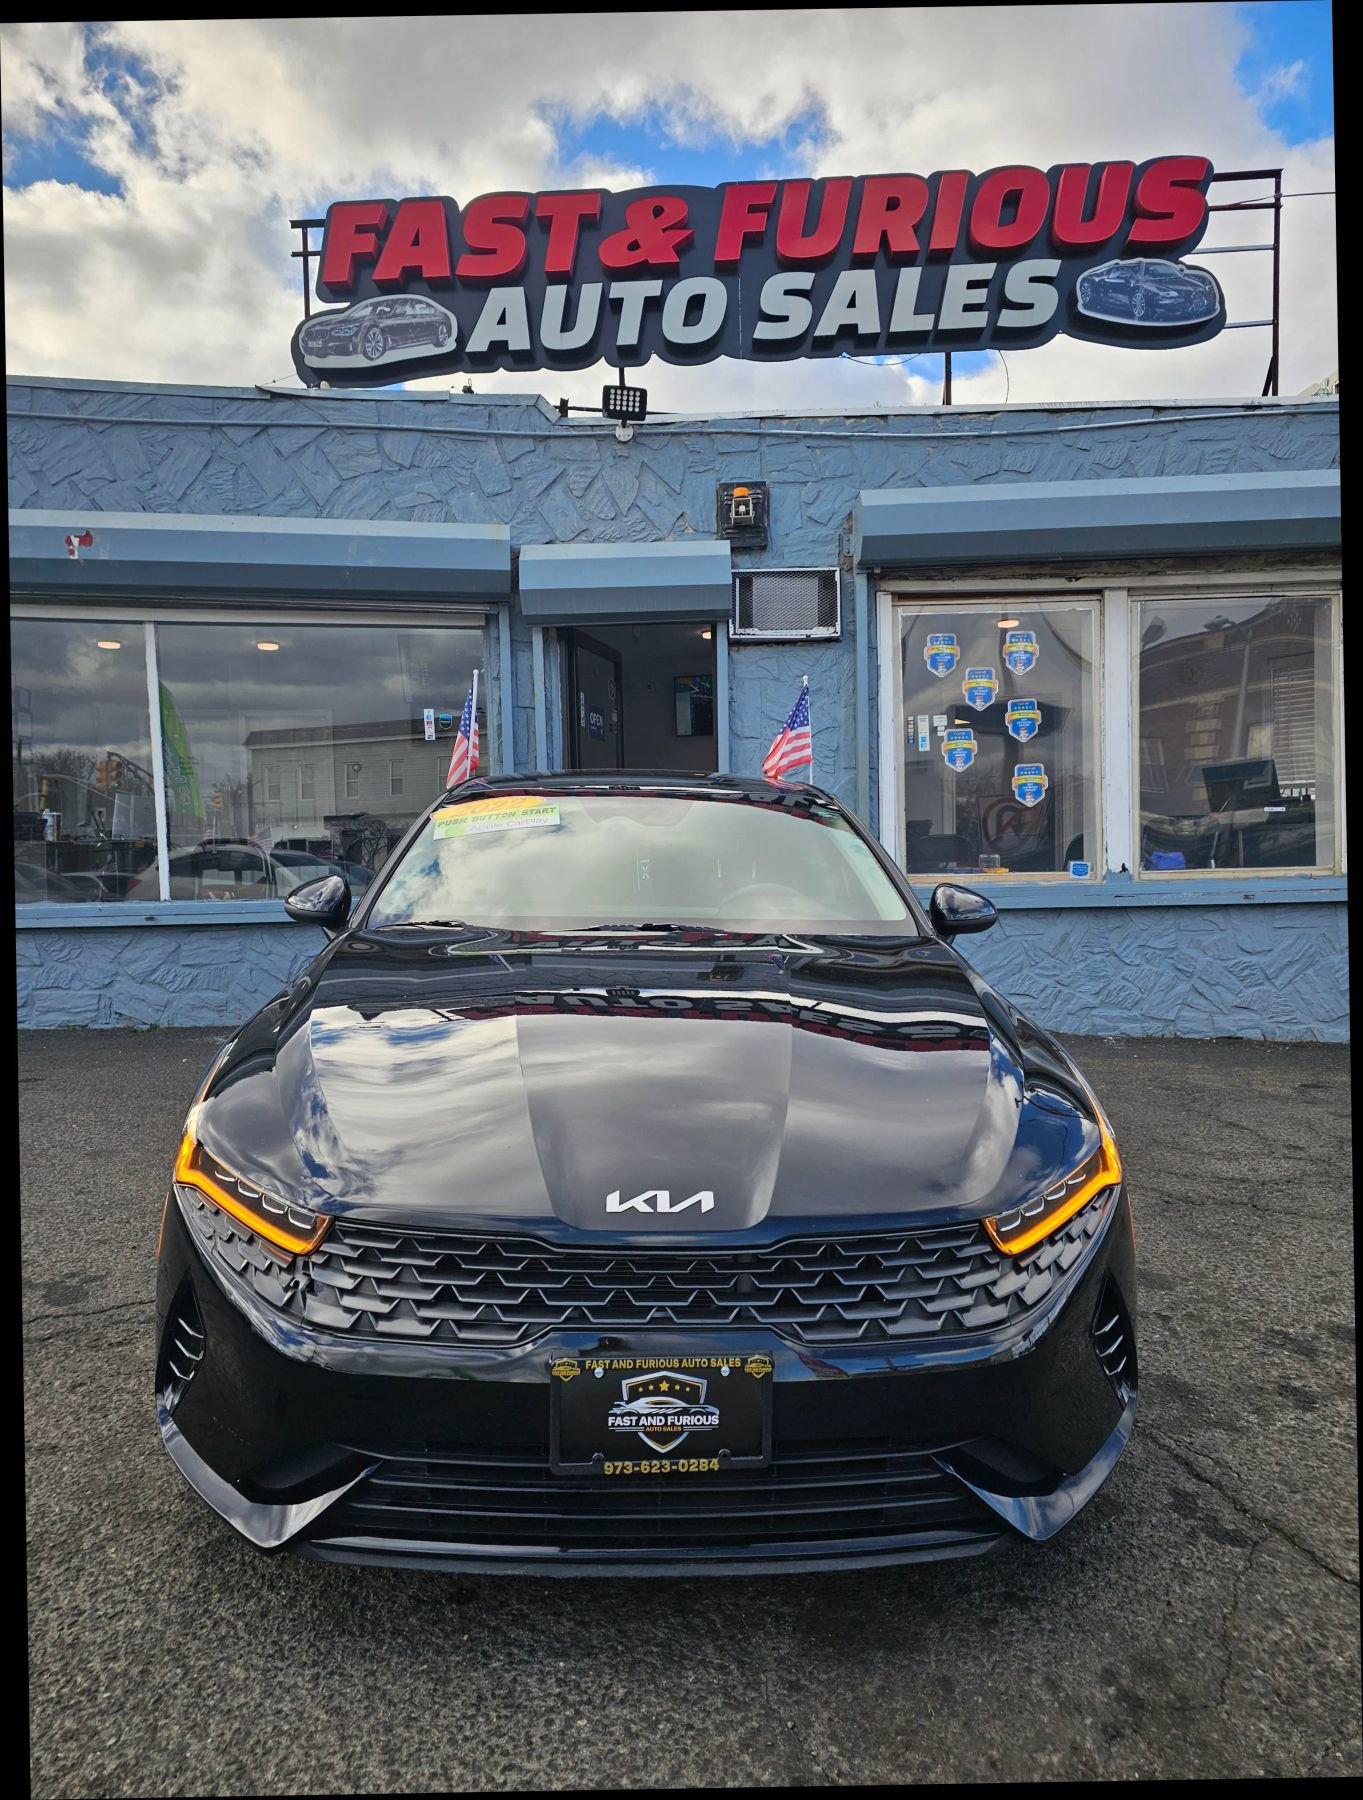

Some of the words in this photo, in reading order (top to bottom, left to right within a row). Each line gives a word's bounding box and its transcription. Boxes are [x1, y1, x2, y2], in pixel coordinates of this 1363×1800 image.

[323, 192, 601, 287] FAST
[599, 196, 695, 271] &
[714, 156, 1212, 264] FURIOUS
[465, 276, 728, 353] AUTO
[753, 259, 1061, 340] SALES
[590, 711, 604, 727] OPEN
[438, 817, 468, 828] PUSH
[471, 811, 517, 823] BUTTON
[521, 806, 557, 816] START
[470, 822, 504, 833] Apple
[506, 816, 550, 827] CarPlay
[606, 1190, 715, 1214] KIA
[585, 1359, 610, 1369] FAST
[612, 1359, 634, 1369] AND
[636, 1358, 680, 1368] FURIOUS
[681, 1358, 708, 1368] AUTO
[710, 1357, 741, 1368] SALES
[608, 1416, 637, 1427] FAST
[639, 1416, 665, 1426] AND
[667, 1415, 719, 1426] FURIOUS
[603, 1458, 720, 1475] 973-623-0284
